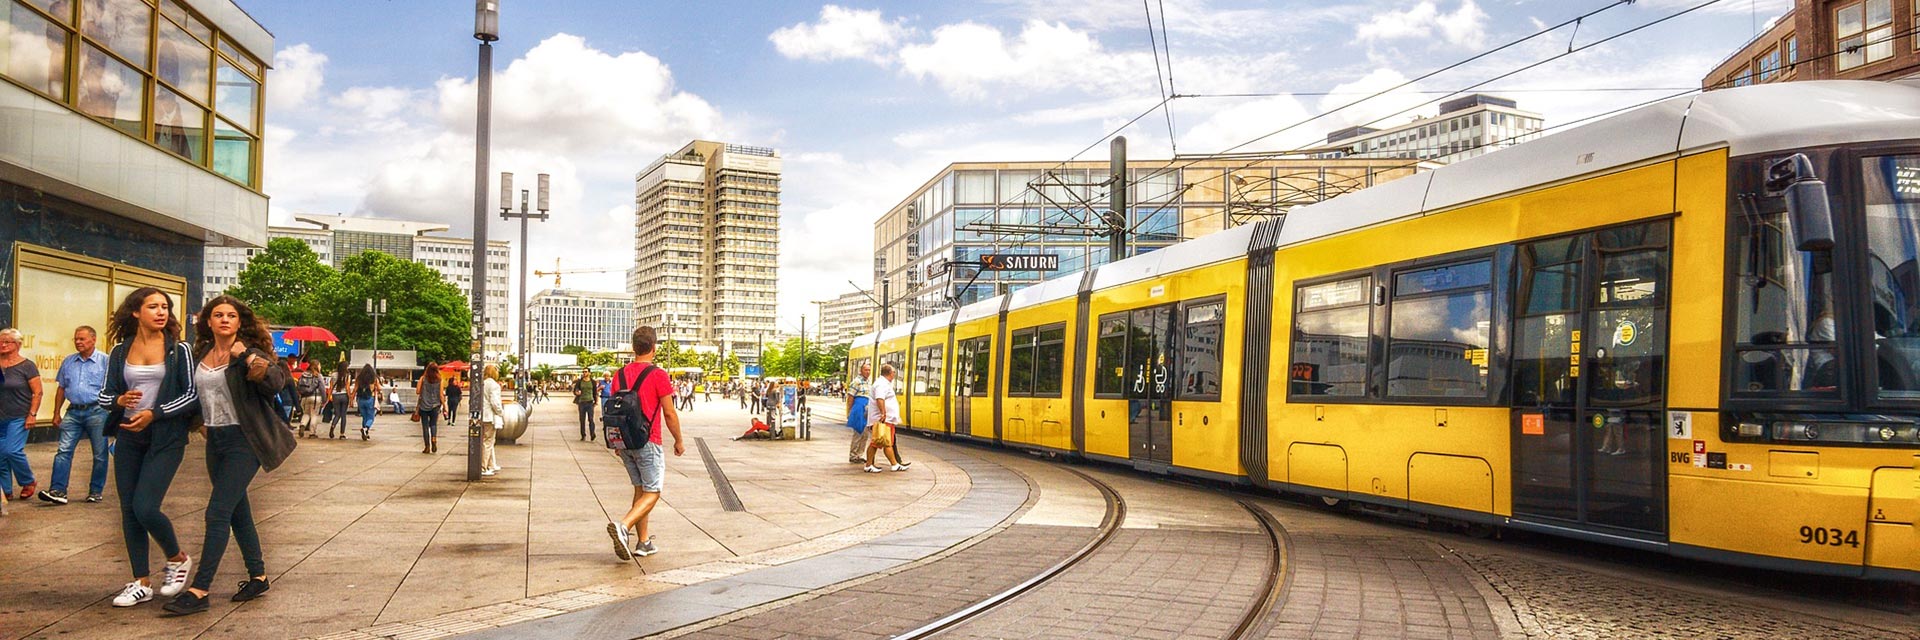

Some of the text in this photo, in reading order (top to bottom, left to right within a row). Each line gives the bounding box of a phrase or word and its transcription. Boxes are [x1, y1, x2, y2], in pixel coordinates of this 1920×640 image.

[1006, 256, 1057, 269] SATURN
[35, 354, 64, 370] Wohlf
[1671, 452, 1690, 463] BVG
[1799, 525, 1860, 548] 9034
